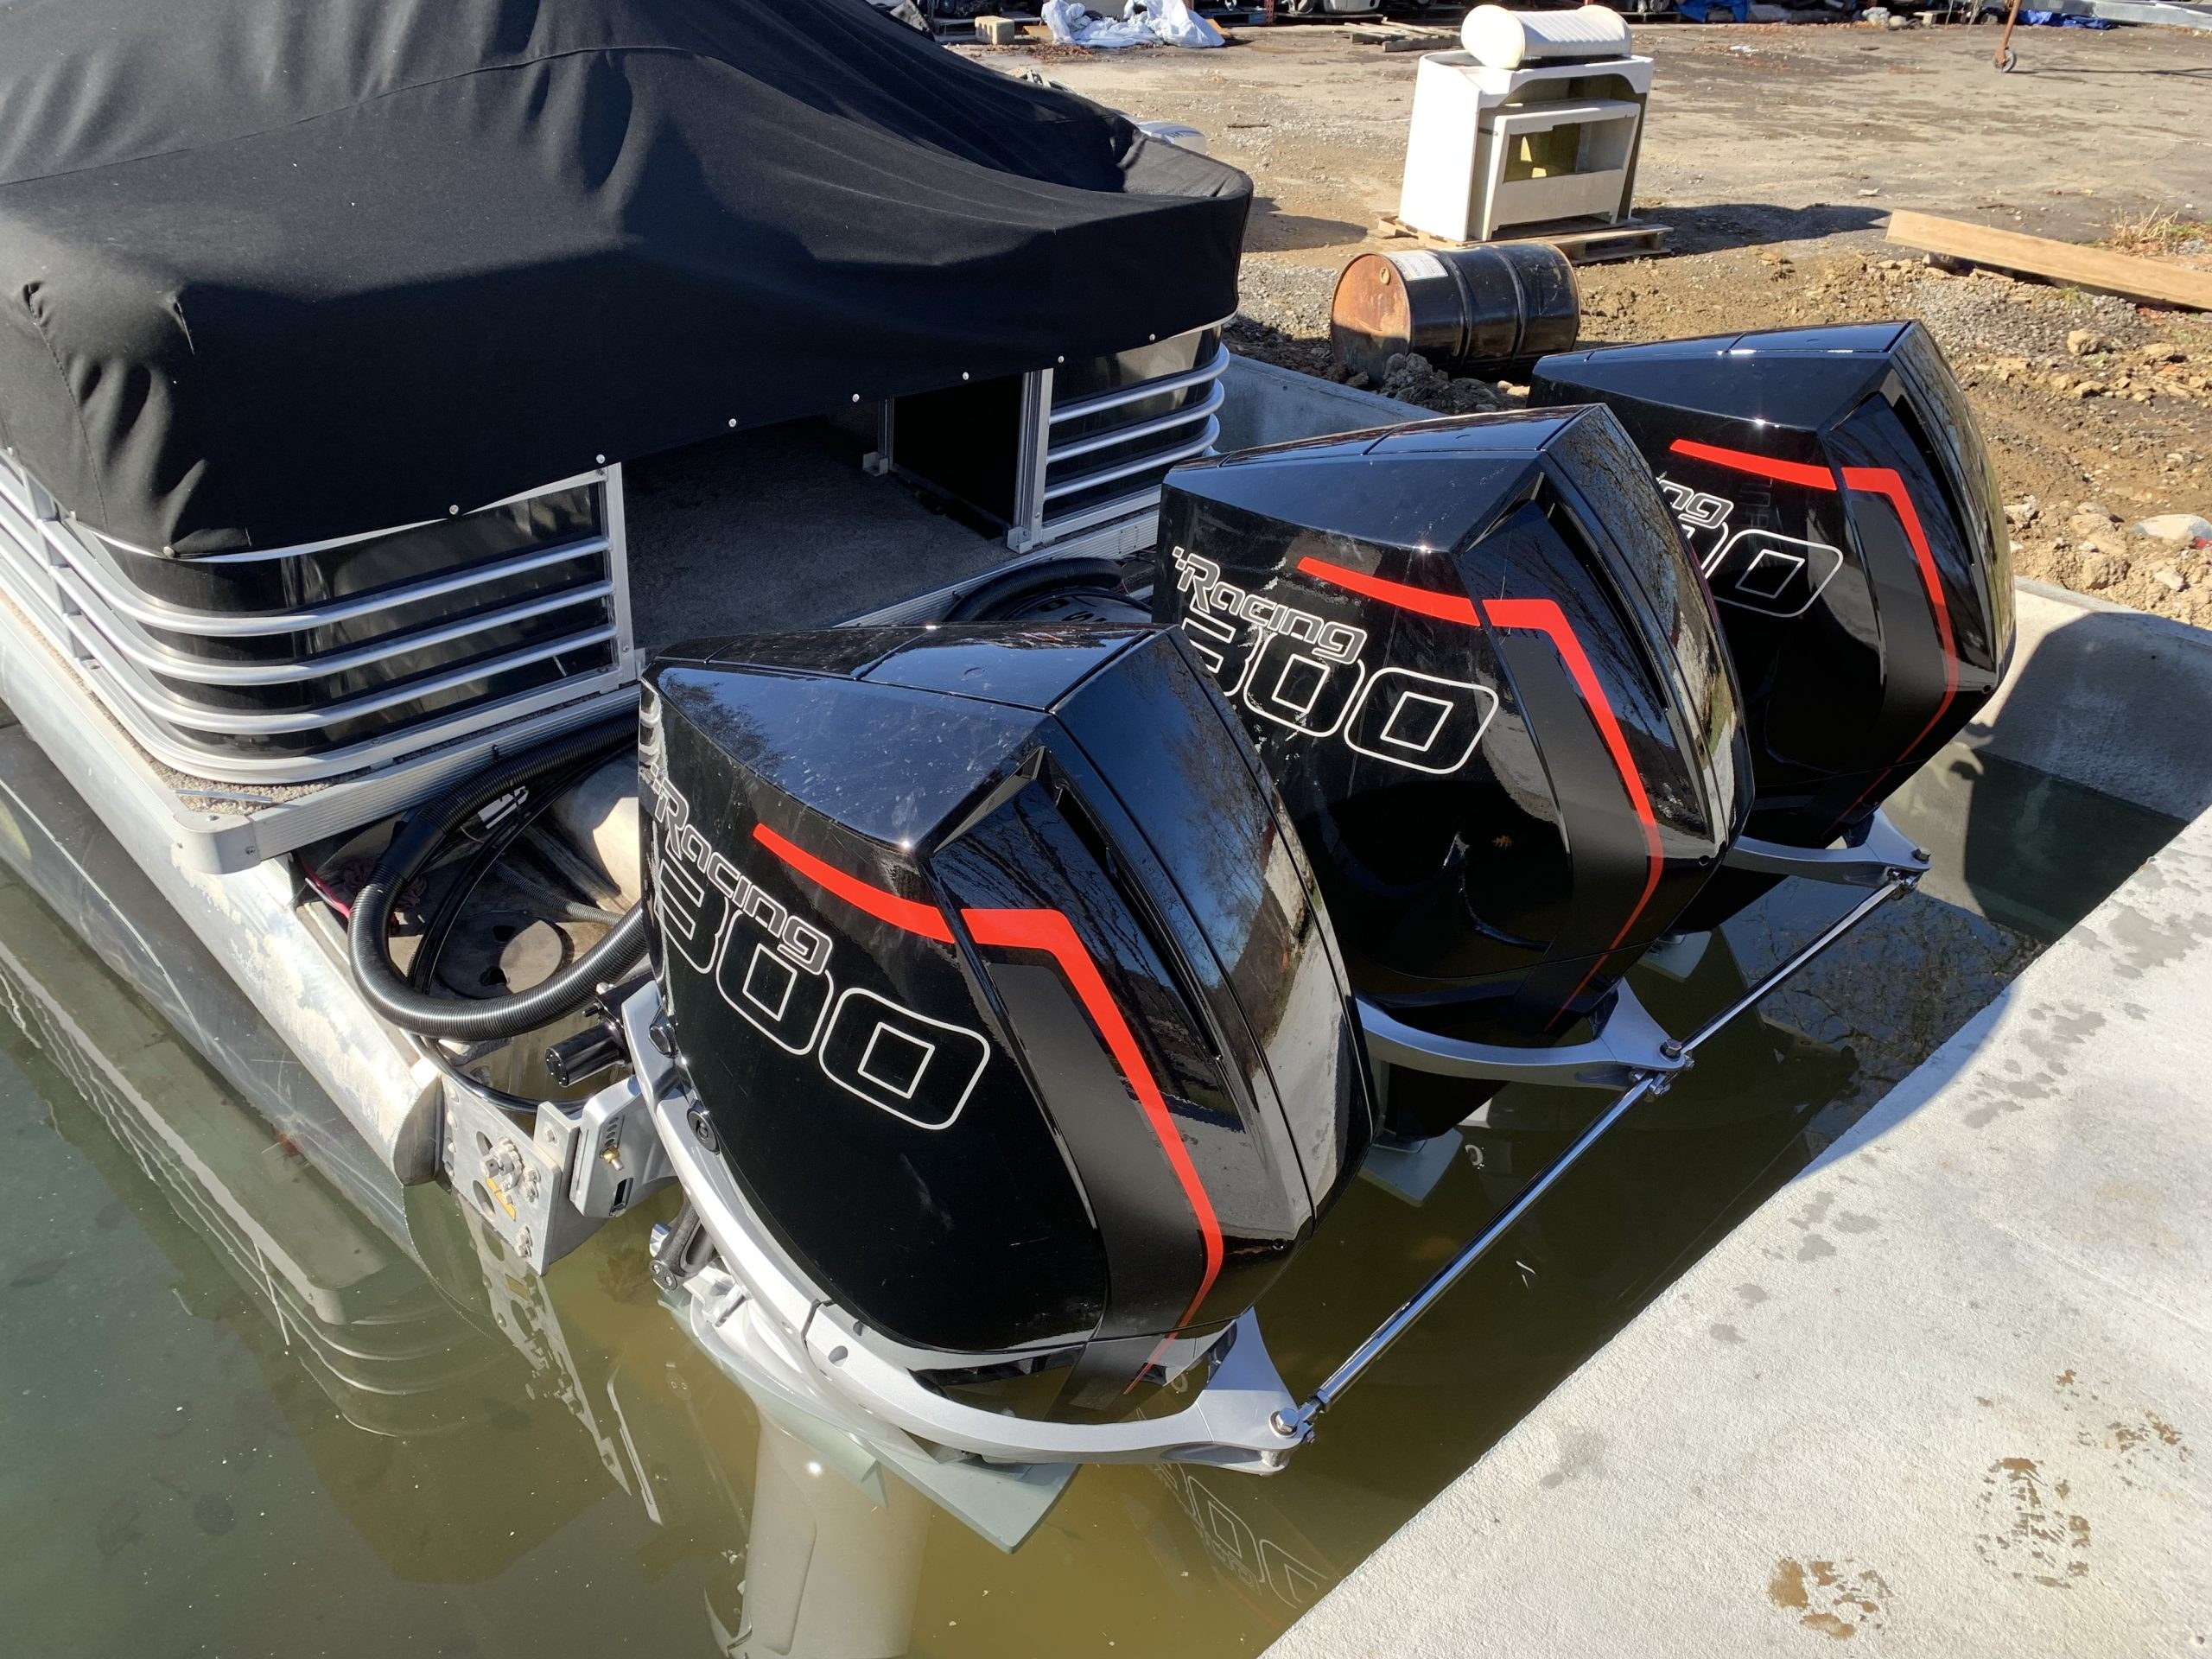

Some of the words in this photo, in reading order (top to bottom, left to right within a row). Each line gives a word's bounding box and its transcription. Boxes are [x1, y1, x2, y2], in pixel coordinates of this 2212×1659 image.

[1173, 546, 1368, 664] Racing
[1181, 610, 1500, 774] 300
[651, 764, 833, 976] Racing
[656, 854, 991, 1130] 300
